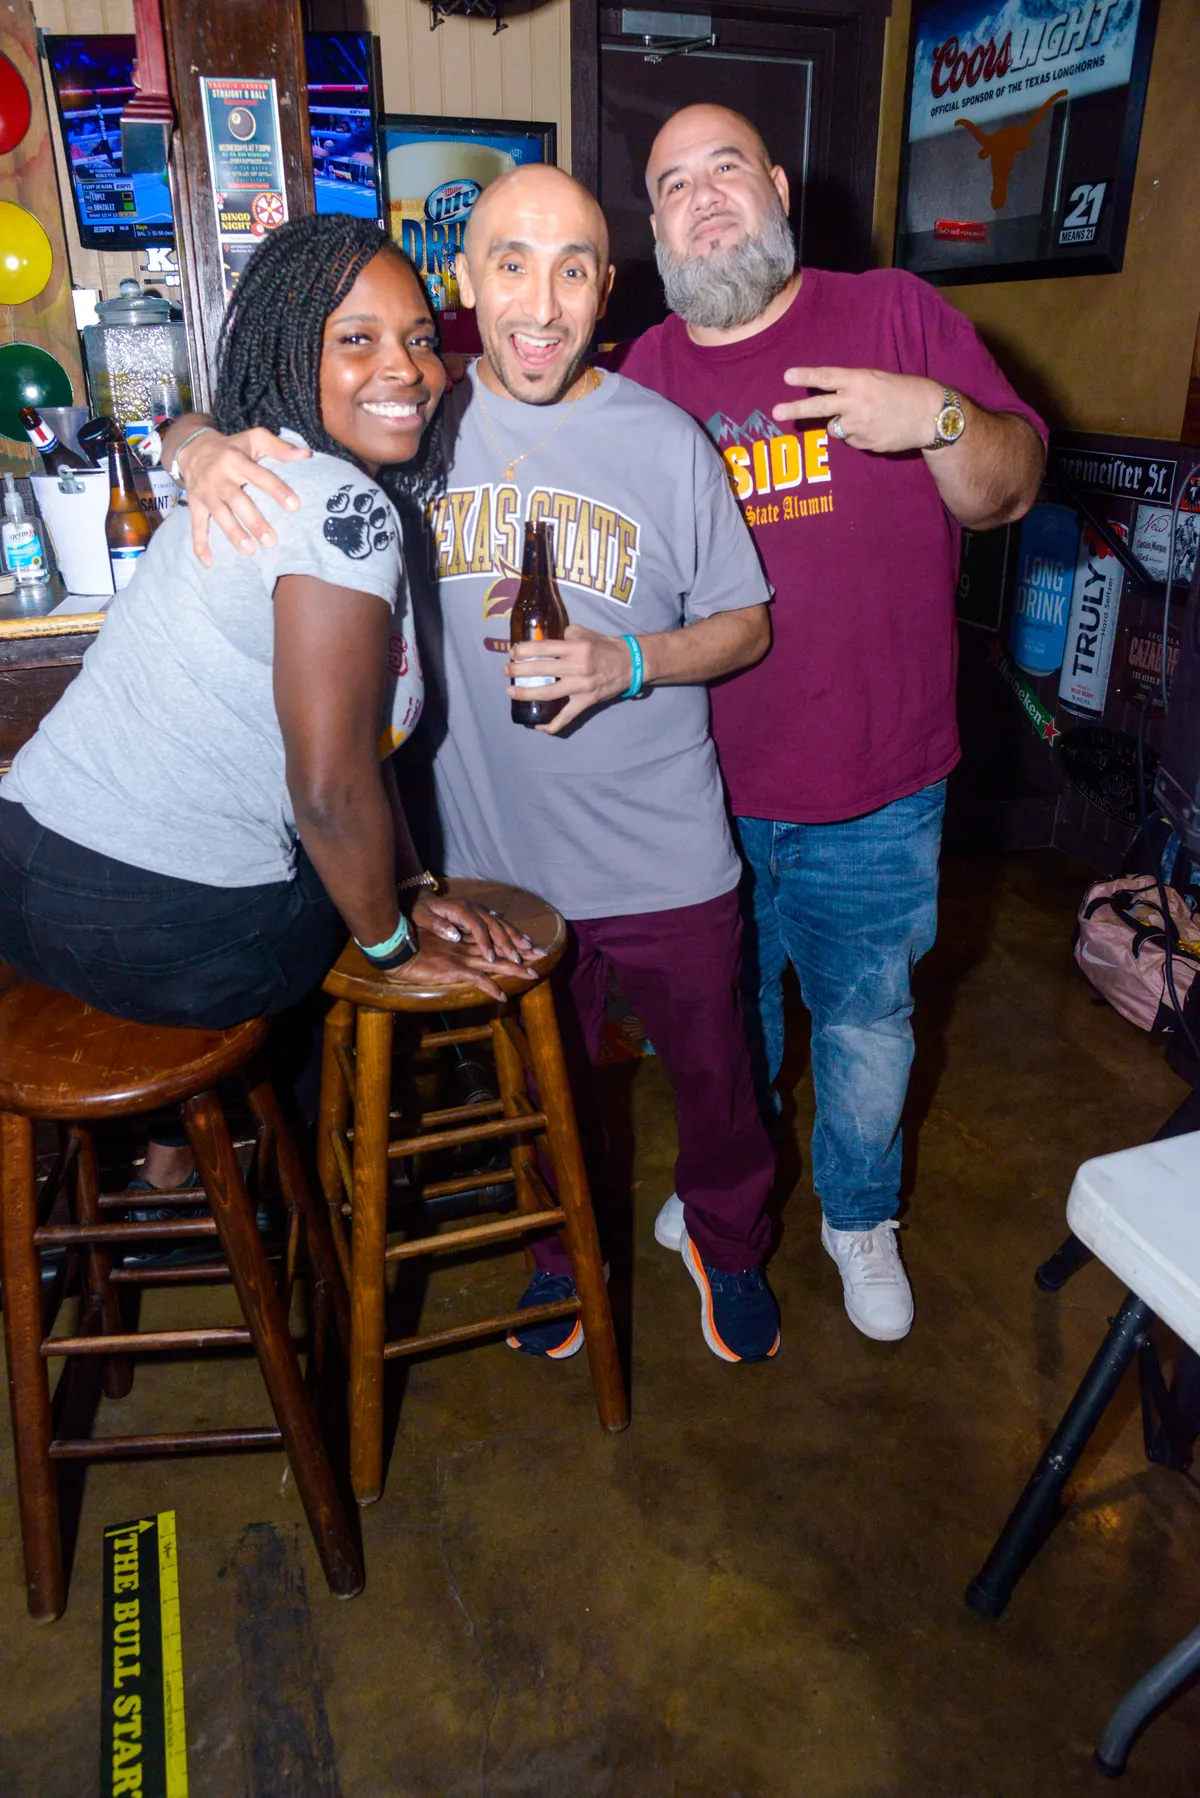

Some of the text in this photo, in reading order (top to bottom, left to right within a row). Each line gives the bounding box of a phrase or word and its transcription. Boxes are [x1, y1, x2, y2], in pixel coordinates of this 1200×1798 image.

[930, 0, 1120, 99] Coors LIGHT
[212, 89, 243, 99] STRAIGHT
[250, 91, 267, 100] BALL
[930, 55, 1106, 117] OFFICIAL SPONSOR OF THE TEXAS LONGHORNS
[93, 203, 116, 211] GONZALEZ
[434, 188, 477, 225] Lite
[442, 185, 464, 197] Miller
[1063, 182, 1107, 228] 21
[93, 225, 115, 233] ESPN
[220, 212, 251, 221] BINGO
[221, 221, 251, 230] NIGHT
[1061, 229, 1094, 242] MEANS 21
[723, 429, 832, 501] SIDE
[1143, 463, 1168, 496] St.
[140, 495, 169, 512] SAINT
[744, 489, 834, 527] State Alumni
[1140, 513, 1172, 534] New
[1023, 554, 1065, 593] LONG
[1015, 584, 1066, 627] DRINK
[1072, 562, 1107, 677] TRULY
[1100, 577, 1113, 636] Hard Seltzer
[1148, 631, 1180, 646] TEQILA
[998, 657, 1043, 725] Heineken
[112, 1532, 144, 1798] THE BULL STAR
